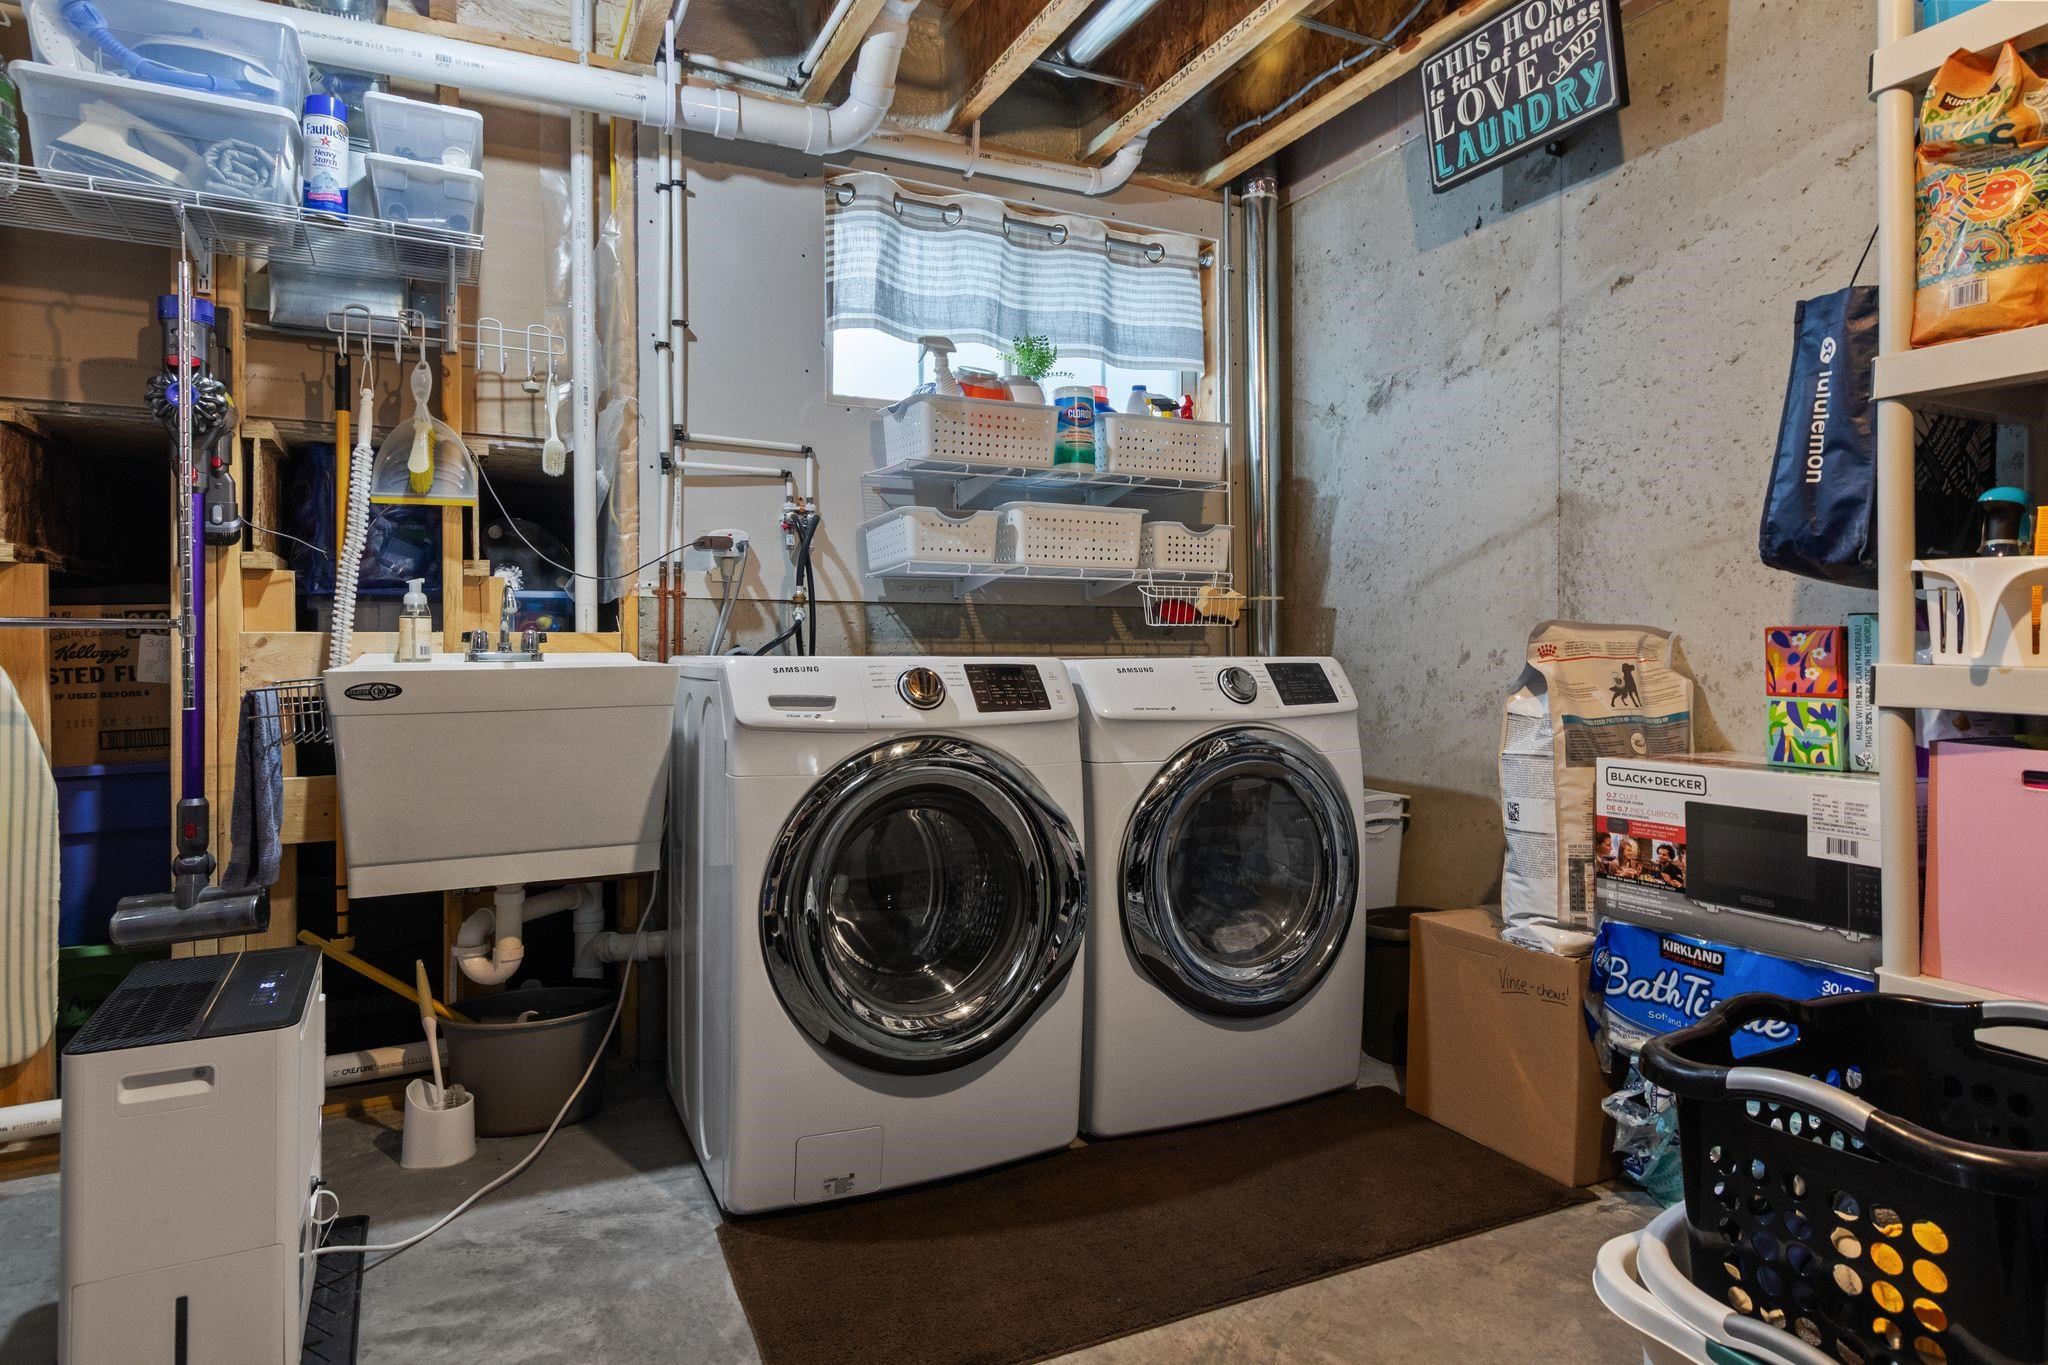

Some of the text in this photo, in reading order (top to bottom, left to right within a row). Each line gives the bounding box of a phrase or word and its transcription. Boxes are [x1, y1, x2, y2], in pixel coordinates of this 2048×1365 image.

[1427, 0, 1583, 88] THIS HOM
[1430, 1, 1601, 107] is full of endless
[1432, 28, 1597, 142] LOVE AND
[1435, 60, 1606, 178] LAUNDRY
[314, 148, 337, 159] Heavy
[314, 156, 338, 166] Starch
[1805, 370, 1833, 484] lululemon
[54, 642, 129, 664] Kellogg's
[1864, 644, 1872, 658] THE
[50, 665, 137, 685] STED FL
[772, 666, 820, 674] SAMSUNG
[1854, 625, 1864, 741] MADE WITH 92% PLANT MATERIAL!
[68, 692, 97, 700] USED
[100, 690, 142, 698] BEFORE
[1865, 711, 1873, 725] 92%
[1865, 726, 1873, 748] THAT'S
[1610, 772, 1702, 790] BLACK+DECKER
[1606, 804, 1616, 812] DE
[1662, 938, 1723, 966] KIRKLAND
[1499, 966, 1528, 992] Vince
[1605, 956, 1686, 1010] Bath
[1667, 1017, 1682, 1028] and
